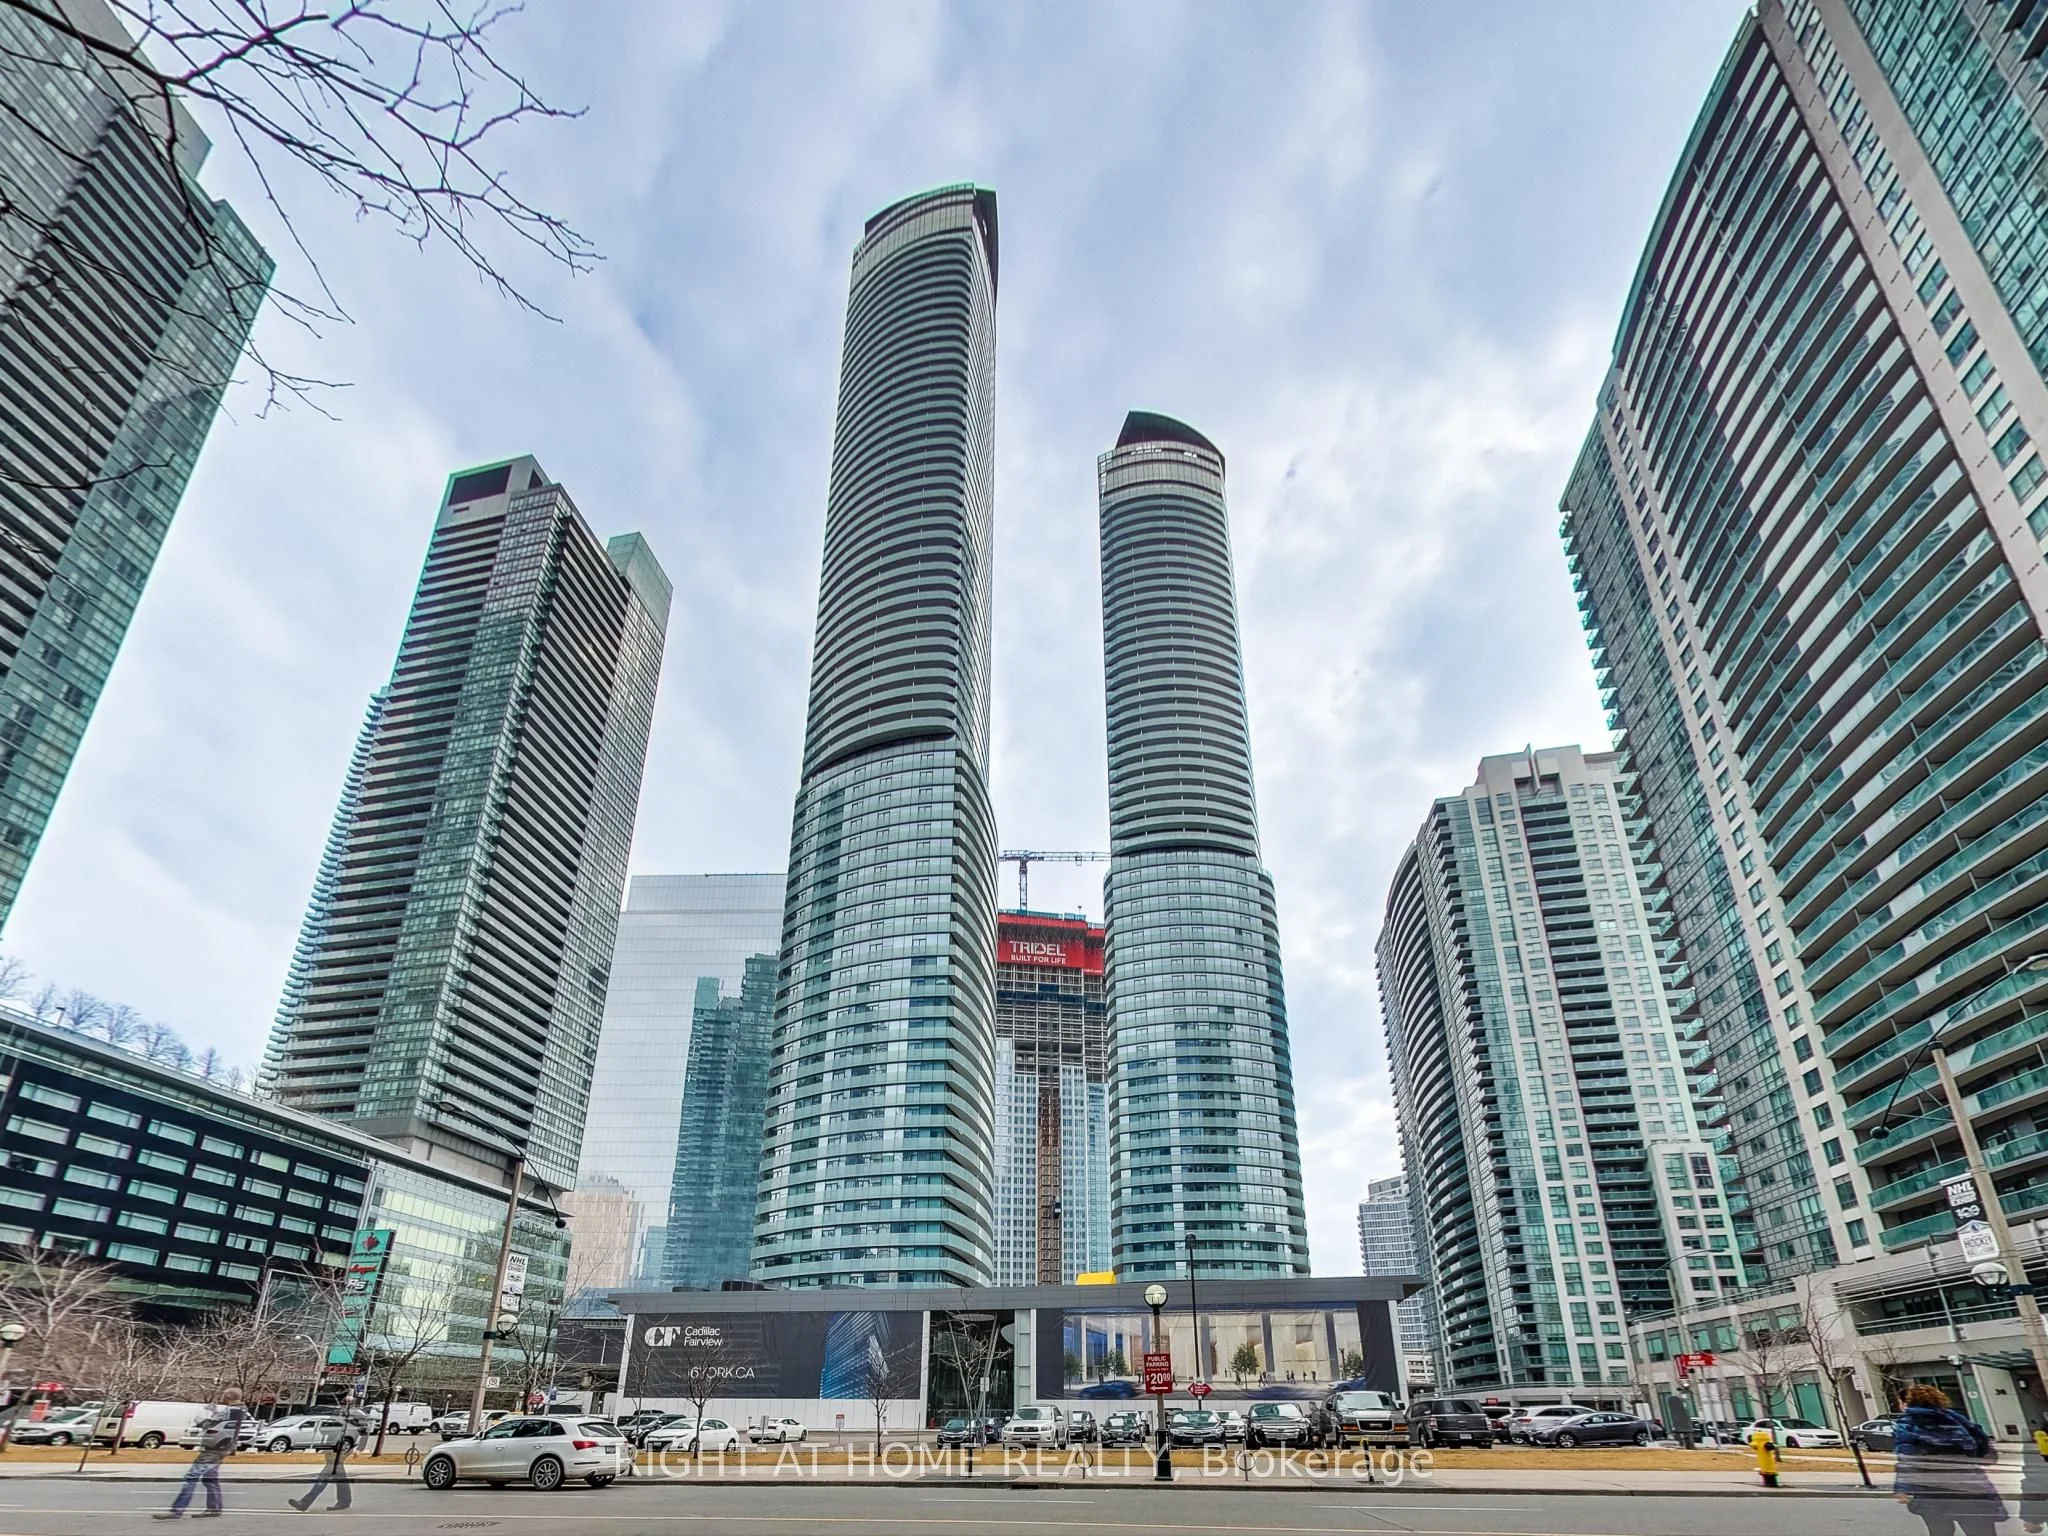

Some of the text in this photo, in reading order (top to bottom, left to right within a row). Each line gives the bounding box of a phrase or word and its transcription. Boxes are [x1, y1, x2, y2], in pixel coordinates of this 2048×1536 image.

[1009, 941, 1066, 956] TRIDEL
[1947, 1181, 1974, 1196] NHL
[509, 1255, 526, 1265] NHL
[644, 1326, 681, 1347] CF
[684, 1326, 721, 1336] Cadillac
[684, 1336, 724, 1346] Fairview
